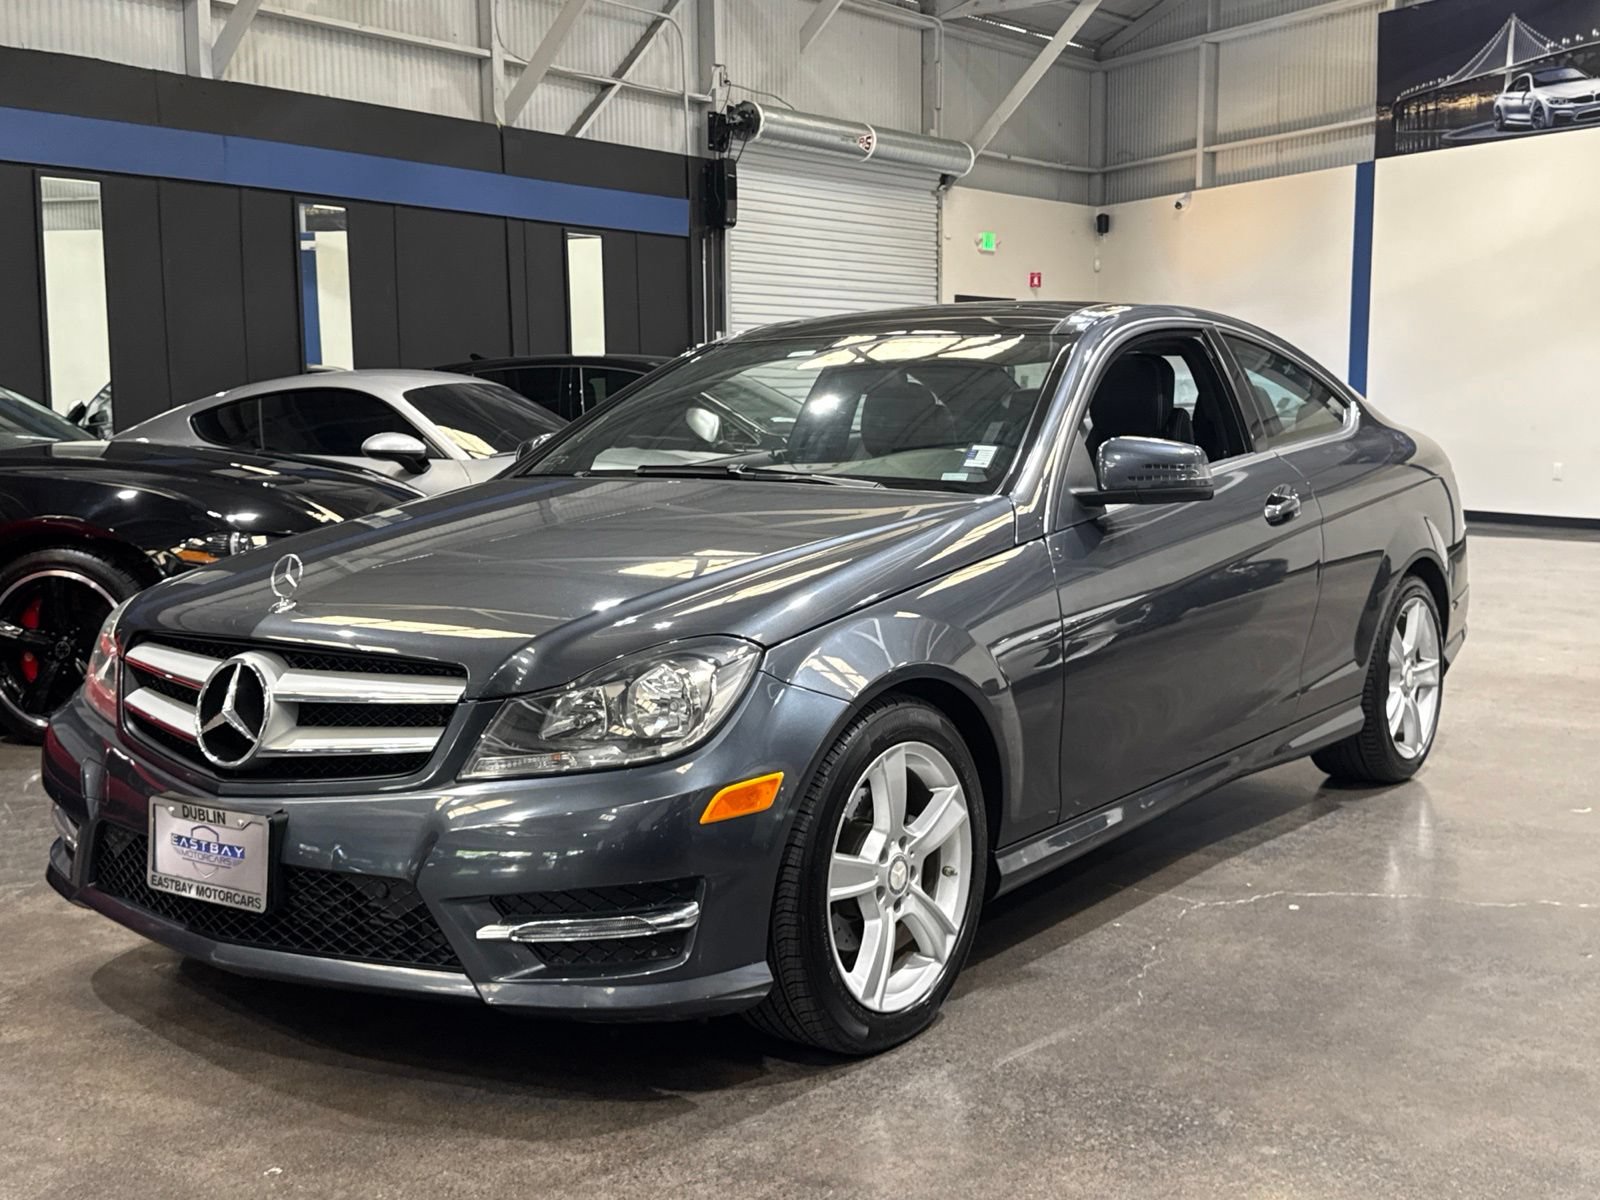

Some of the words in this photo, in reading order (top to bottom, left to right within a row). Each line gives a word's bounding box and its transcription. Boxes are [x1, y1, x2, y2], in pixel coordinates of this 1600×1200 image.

[182, 804, 226, 825] DUBLIN
[171, 834, 244, 858] EASTBAY
[180, 849, 233, 866] MOTORCARS
[151, 875, 193, 893] EASTBAY
[196, 885, 262, 909] MOTORCARS
